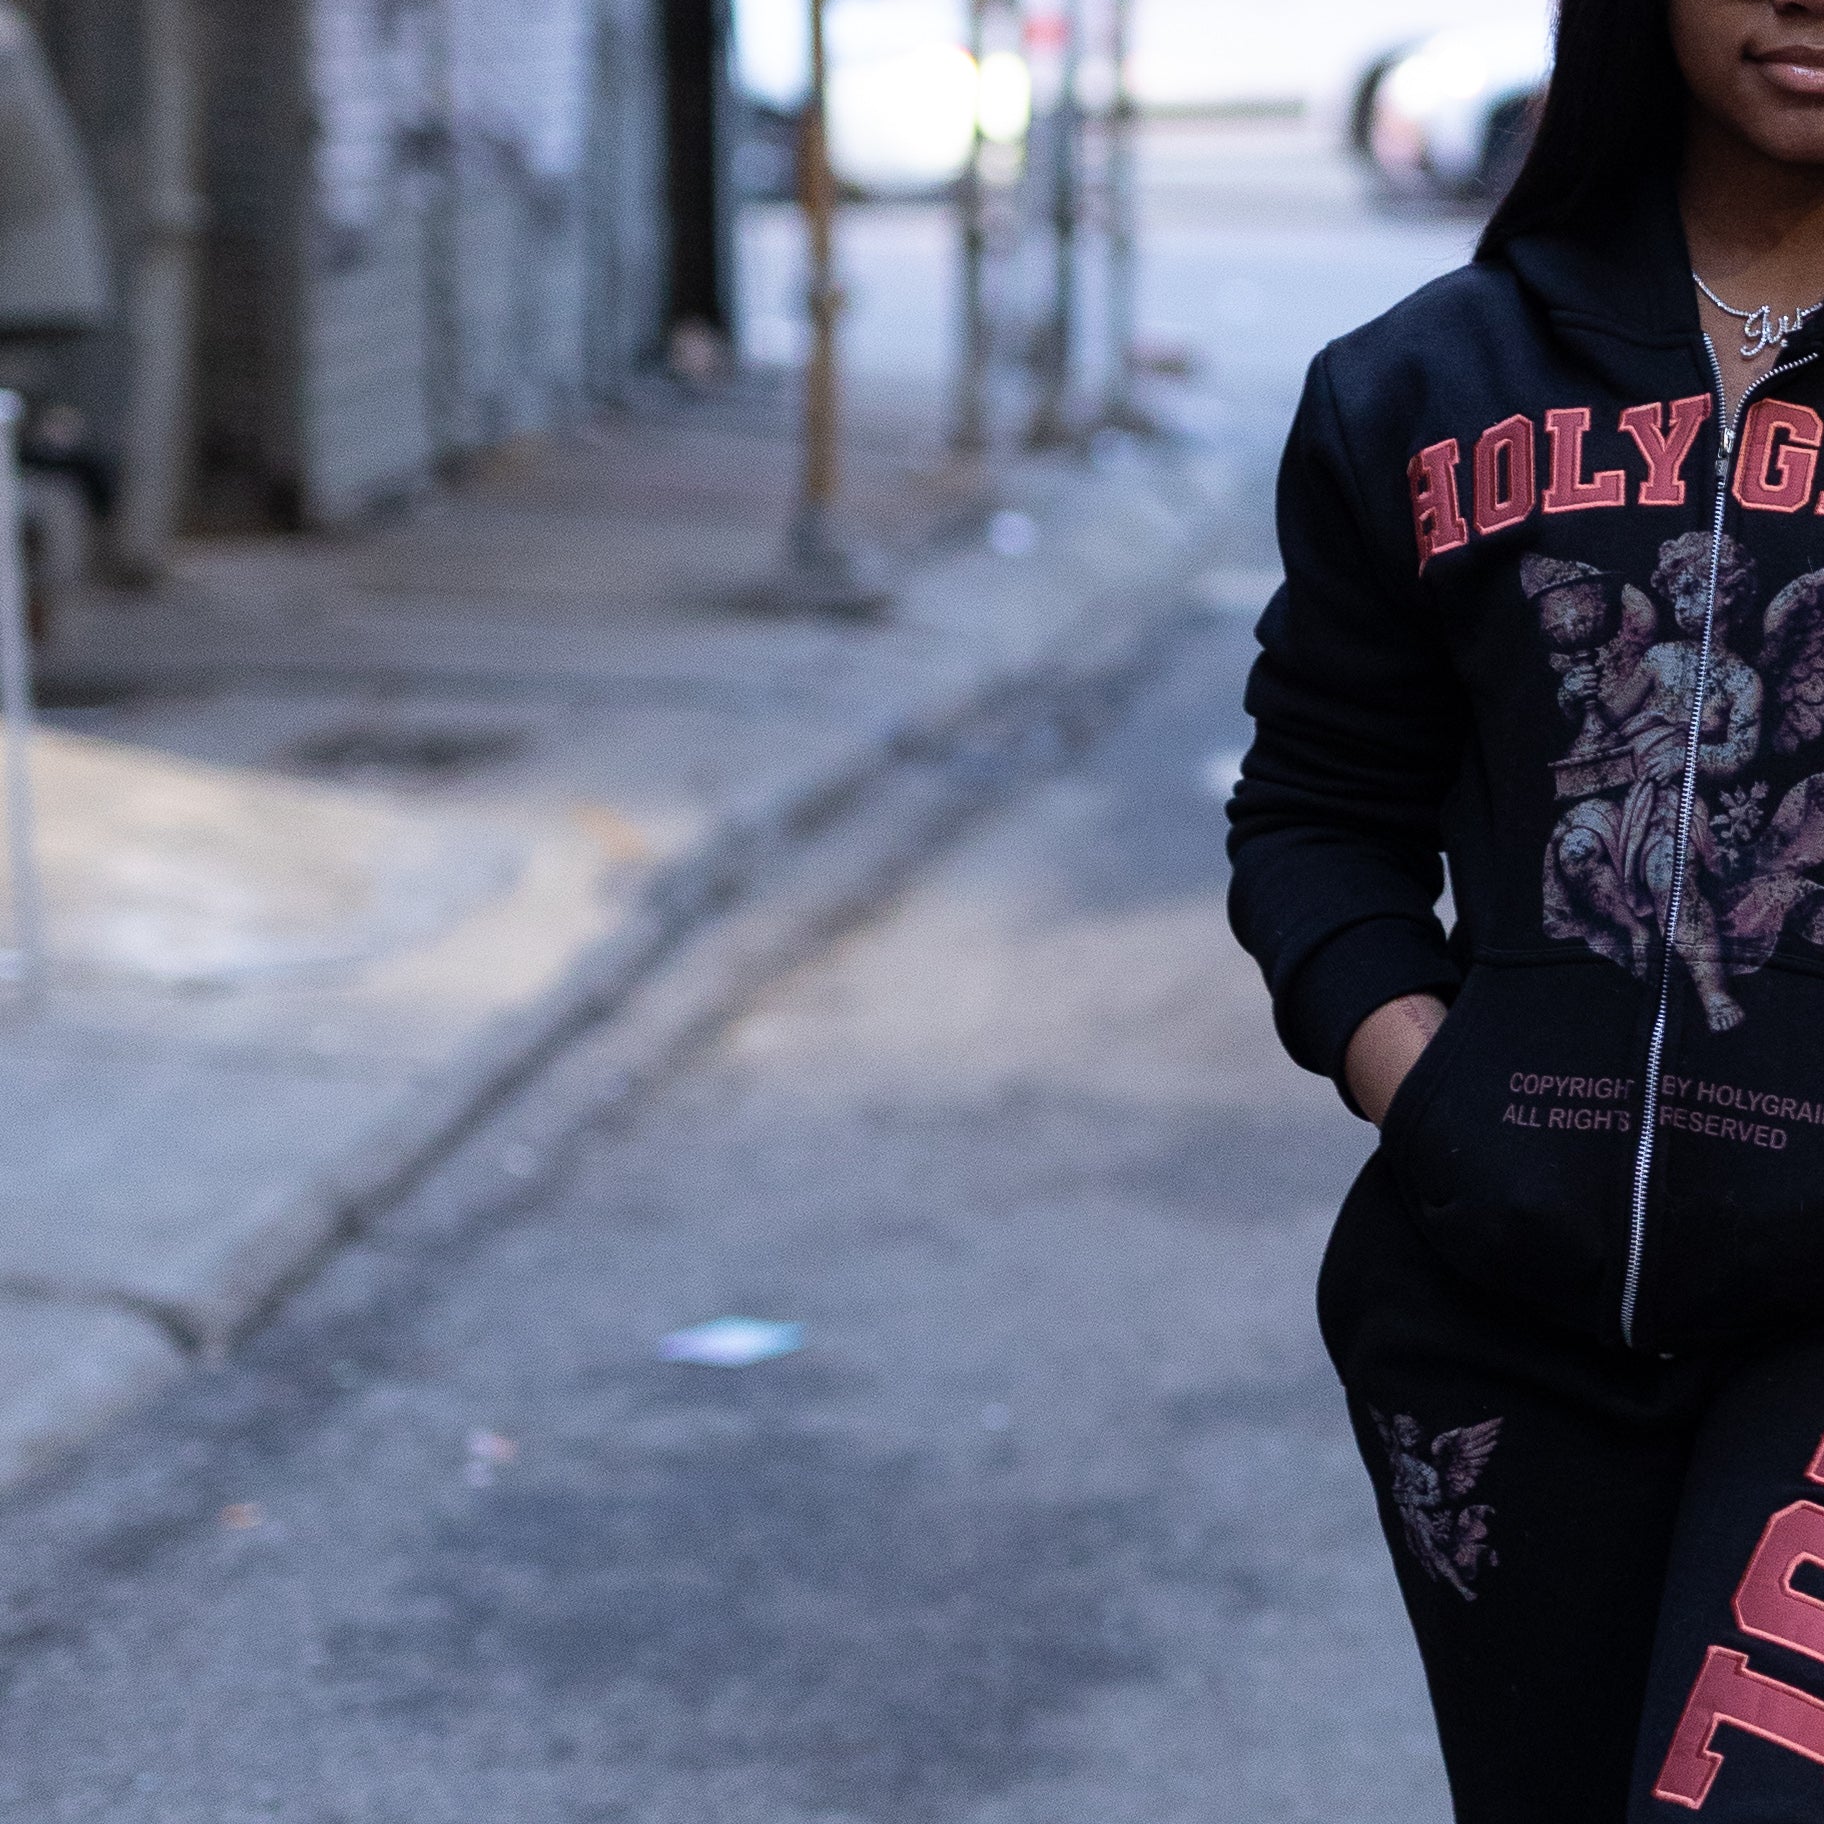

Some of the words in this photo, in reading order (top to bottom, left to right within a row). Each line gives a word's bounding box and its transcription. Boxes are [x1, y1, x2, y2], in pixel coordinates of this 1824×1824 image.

[1407, 392, 1713, 577] HOLY
[1502, 1103, 1542, 1128] ALL
[1547, 1106, 1632, 1133] RIGHTS
[1659, 1104, 1788, 1151] RESERVED
